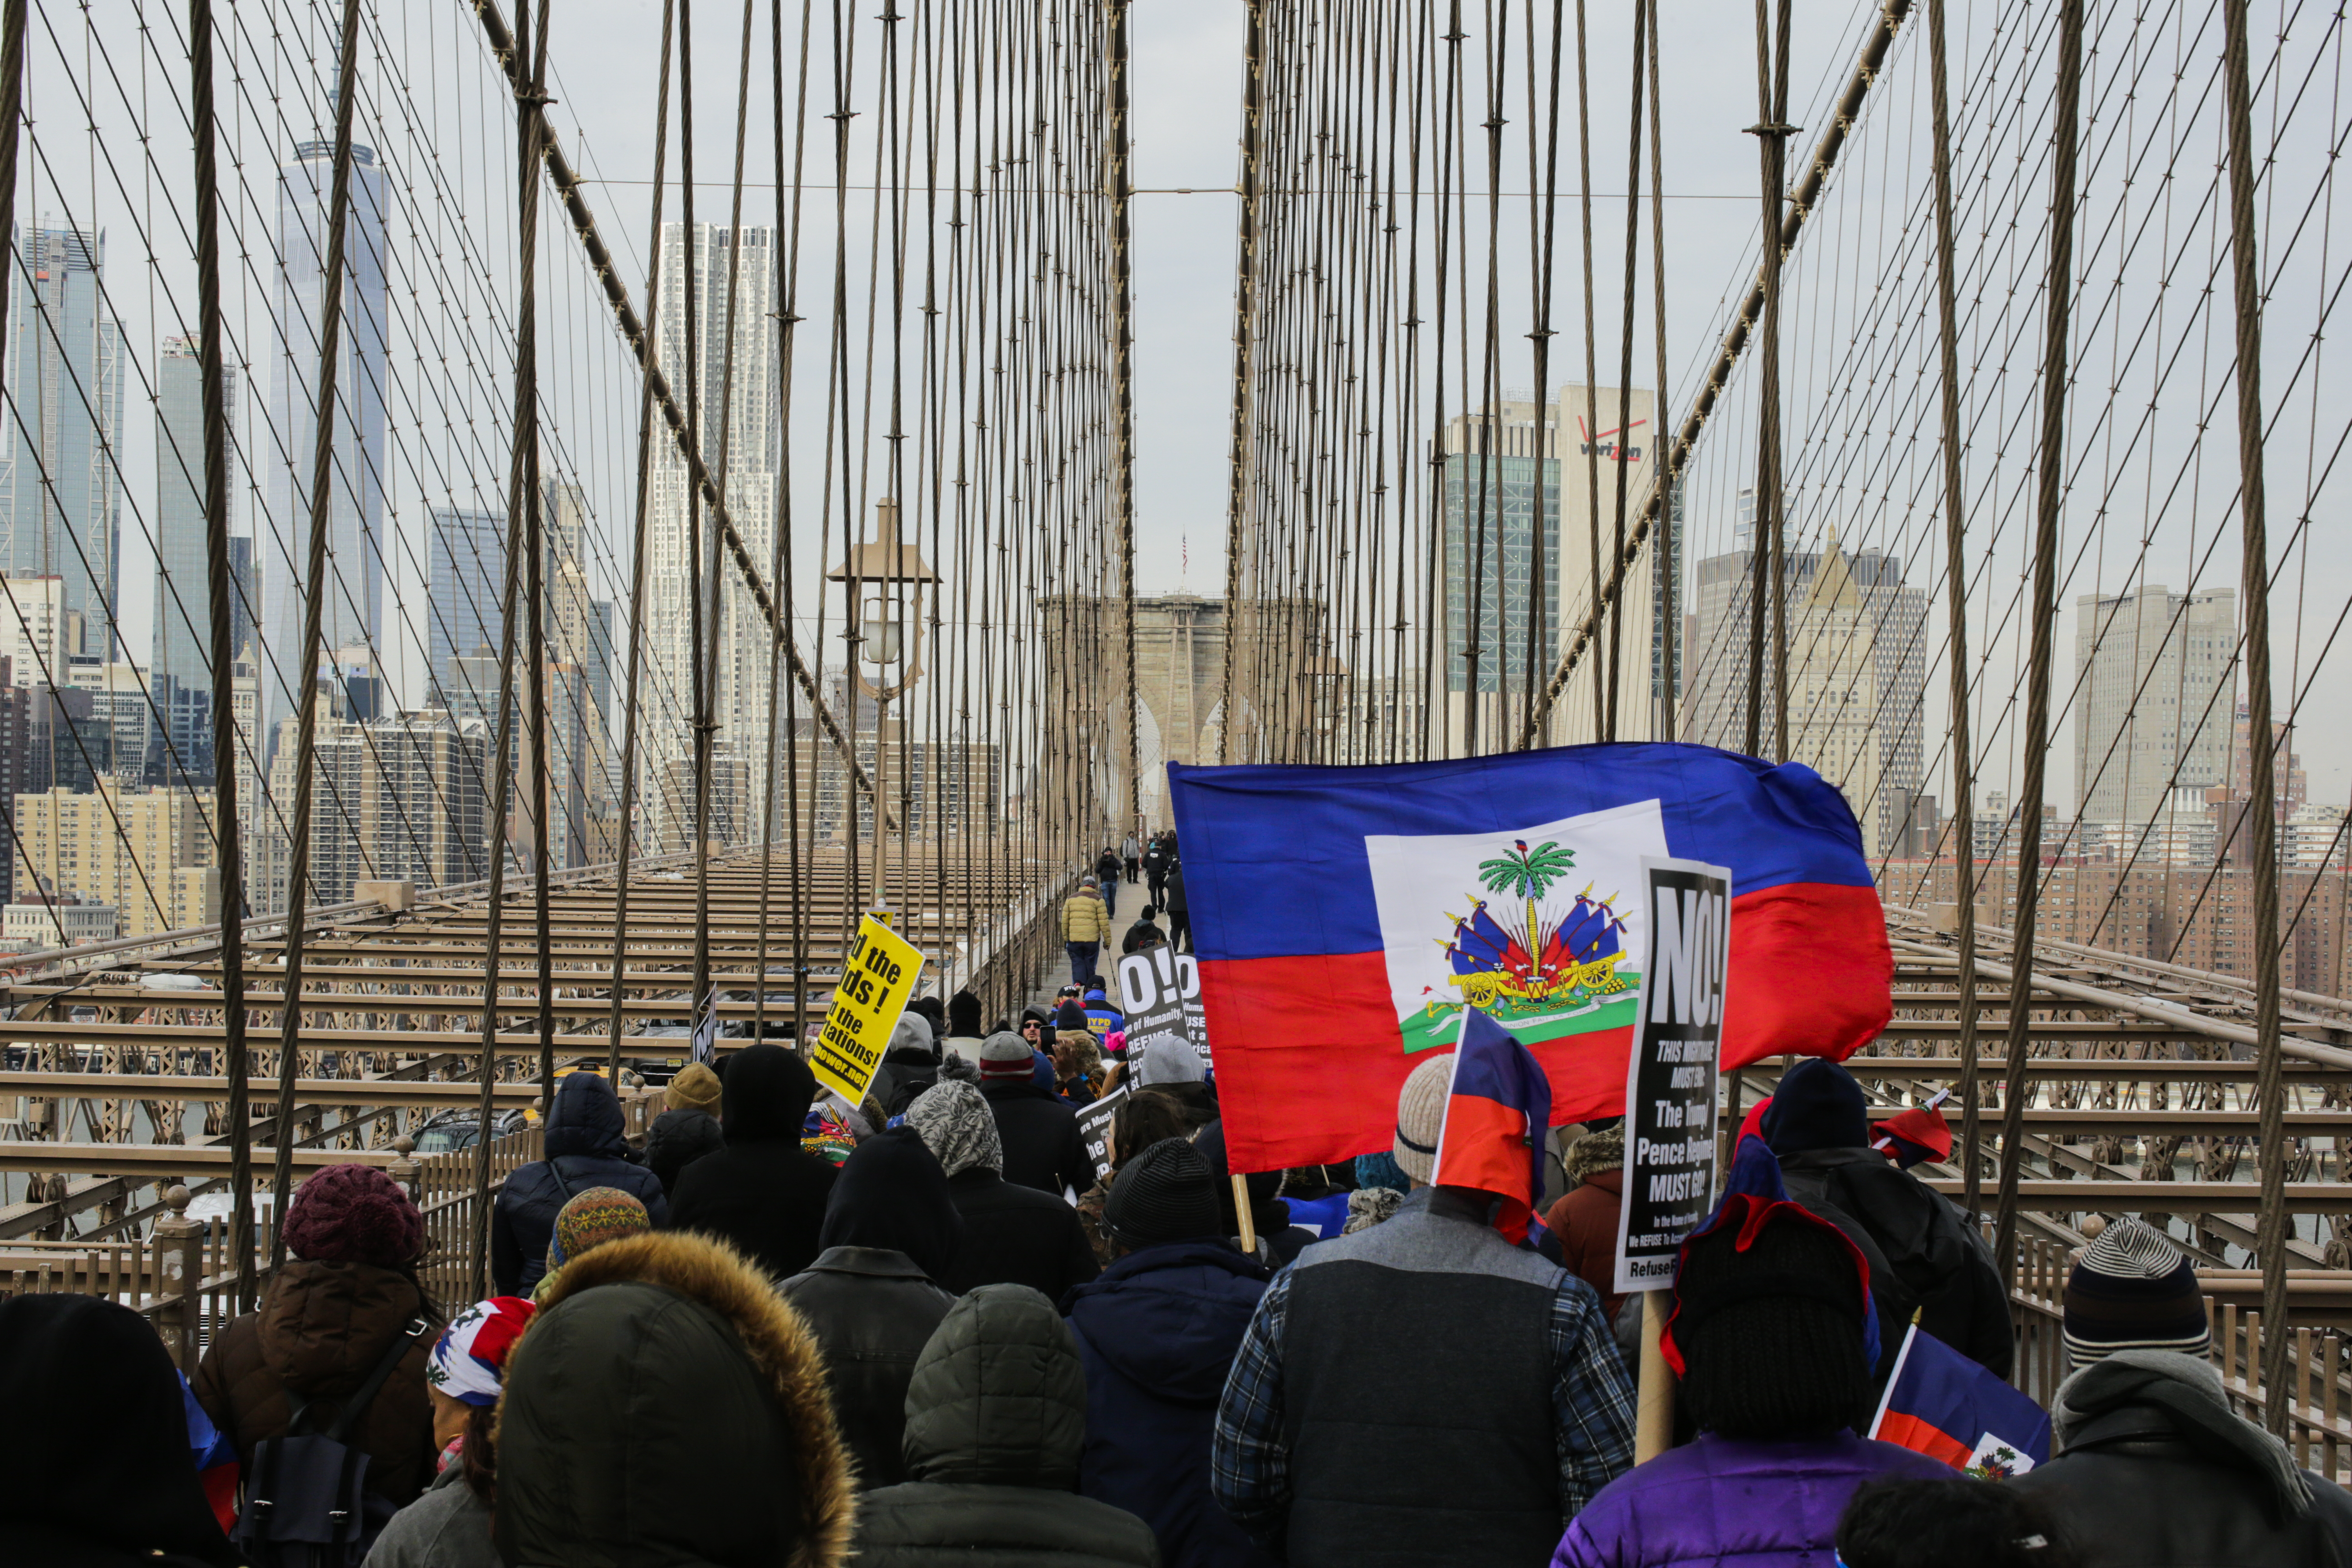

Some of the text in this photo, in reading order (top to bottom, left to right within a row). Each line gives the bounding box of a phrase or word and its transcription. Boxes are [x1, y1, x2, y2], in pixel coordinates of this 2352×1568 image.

[1581, 442, 1641, 461] vrizn
[865, 946, 901, 985] the
[1651, 886, 1723, 1028] NO!
[1119, 946, 1177, 1014] O!
[1134, 1019, 1142, 1030] of
[1144, 1008, 1182, 1028] Humanity,
[1184, 1002, 1204, 1012] Huma
[1567, 1005, 1596, 1016] FORCE
[836, 1007, 863, 1034] the
[823, 1019, 881, 1069] tations!
[1128, 1028, 1173, 1055] REF
[1199, 1032, 1206, 1040] a
[1657, 1040, 1682, 1062] THIS
[814, 1043, 867, 1087] power.net
[1671, 1067, 1695, 1088] MUST
[1091, 1110, 1112, 1127] Must
[1656, 1098, 1709, 1130] The Trump/
[1637, 1134, 1713, 1167] Pence Regime
[1649, 1170, 1705, 1202] MUST GO!
[1654, 1216, 1660, 1228] In
[1661, 1215, 1671, 1227] the
[1629, 1235, 1639, 1248] We
[1640, 1234, 1662, 1247] REFUSE
[1663, 1233, 1670, 1245] To
